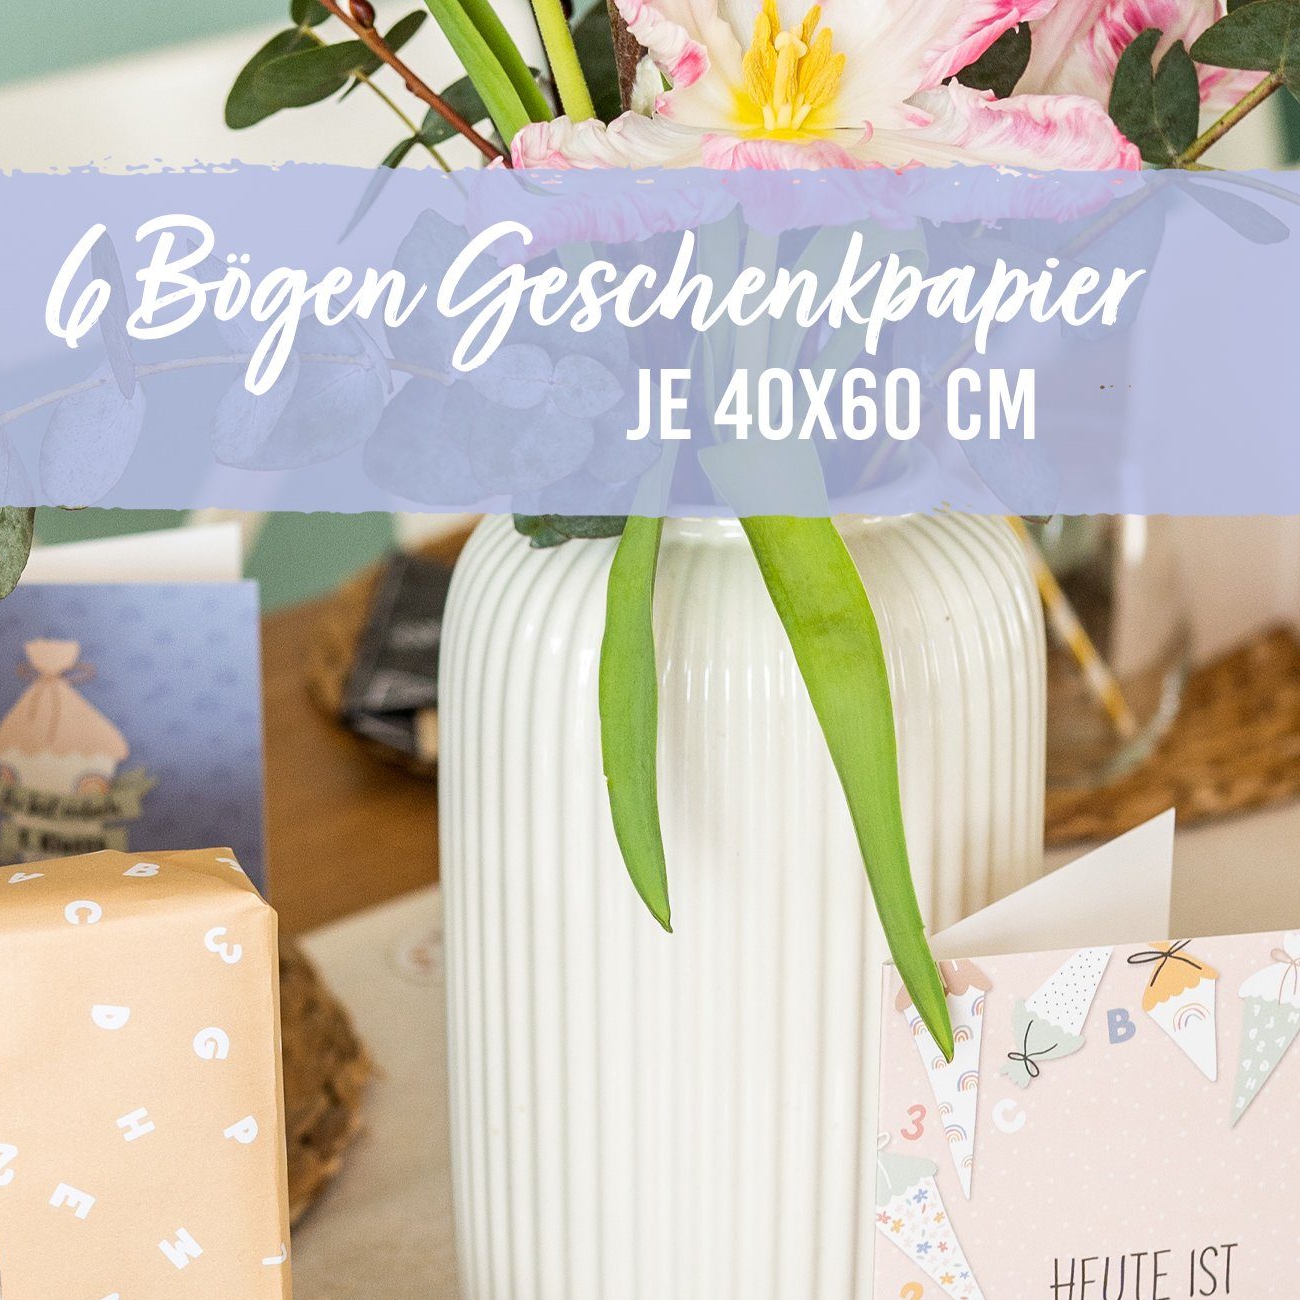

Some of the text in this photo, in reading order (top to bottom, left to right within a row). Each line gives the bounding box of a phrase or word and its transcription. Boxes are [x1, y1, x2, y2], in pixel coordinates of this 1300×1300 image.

[123, 862, 160, 877] B
[64, 900, 102, 925] C
[203, 926, 243, 964] 3
[91, 1004, 131, 1030] D
[1106, 1007, 1137, 1045] B
[192, 1026, 230, 1060] G
[116, 1107, 156, 1142] H
[223, 1115, 258, 1144] P
[900, 1103, 927, 1141] 3
[991, 1097, 1027, 1134] C
[48, 1182, 96, 1220] E
[158, 1227, 204, 1270] M
[1190, 1243, 1239, 1298] IST
